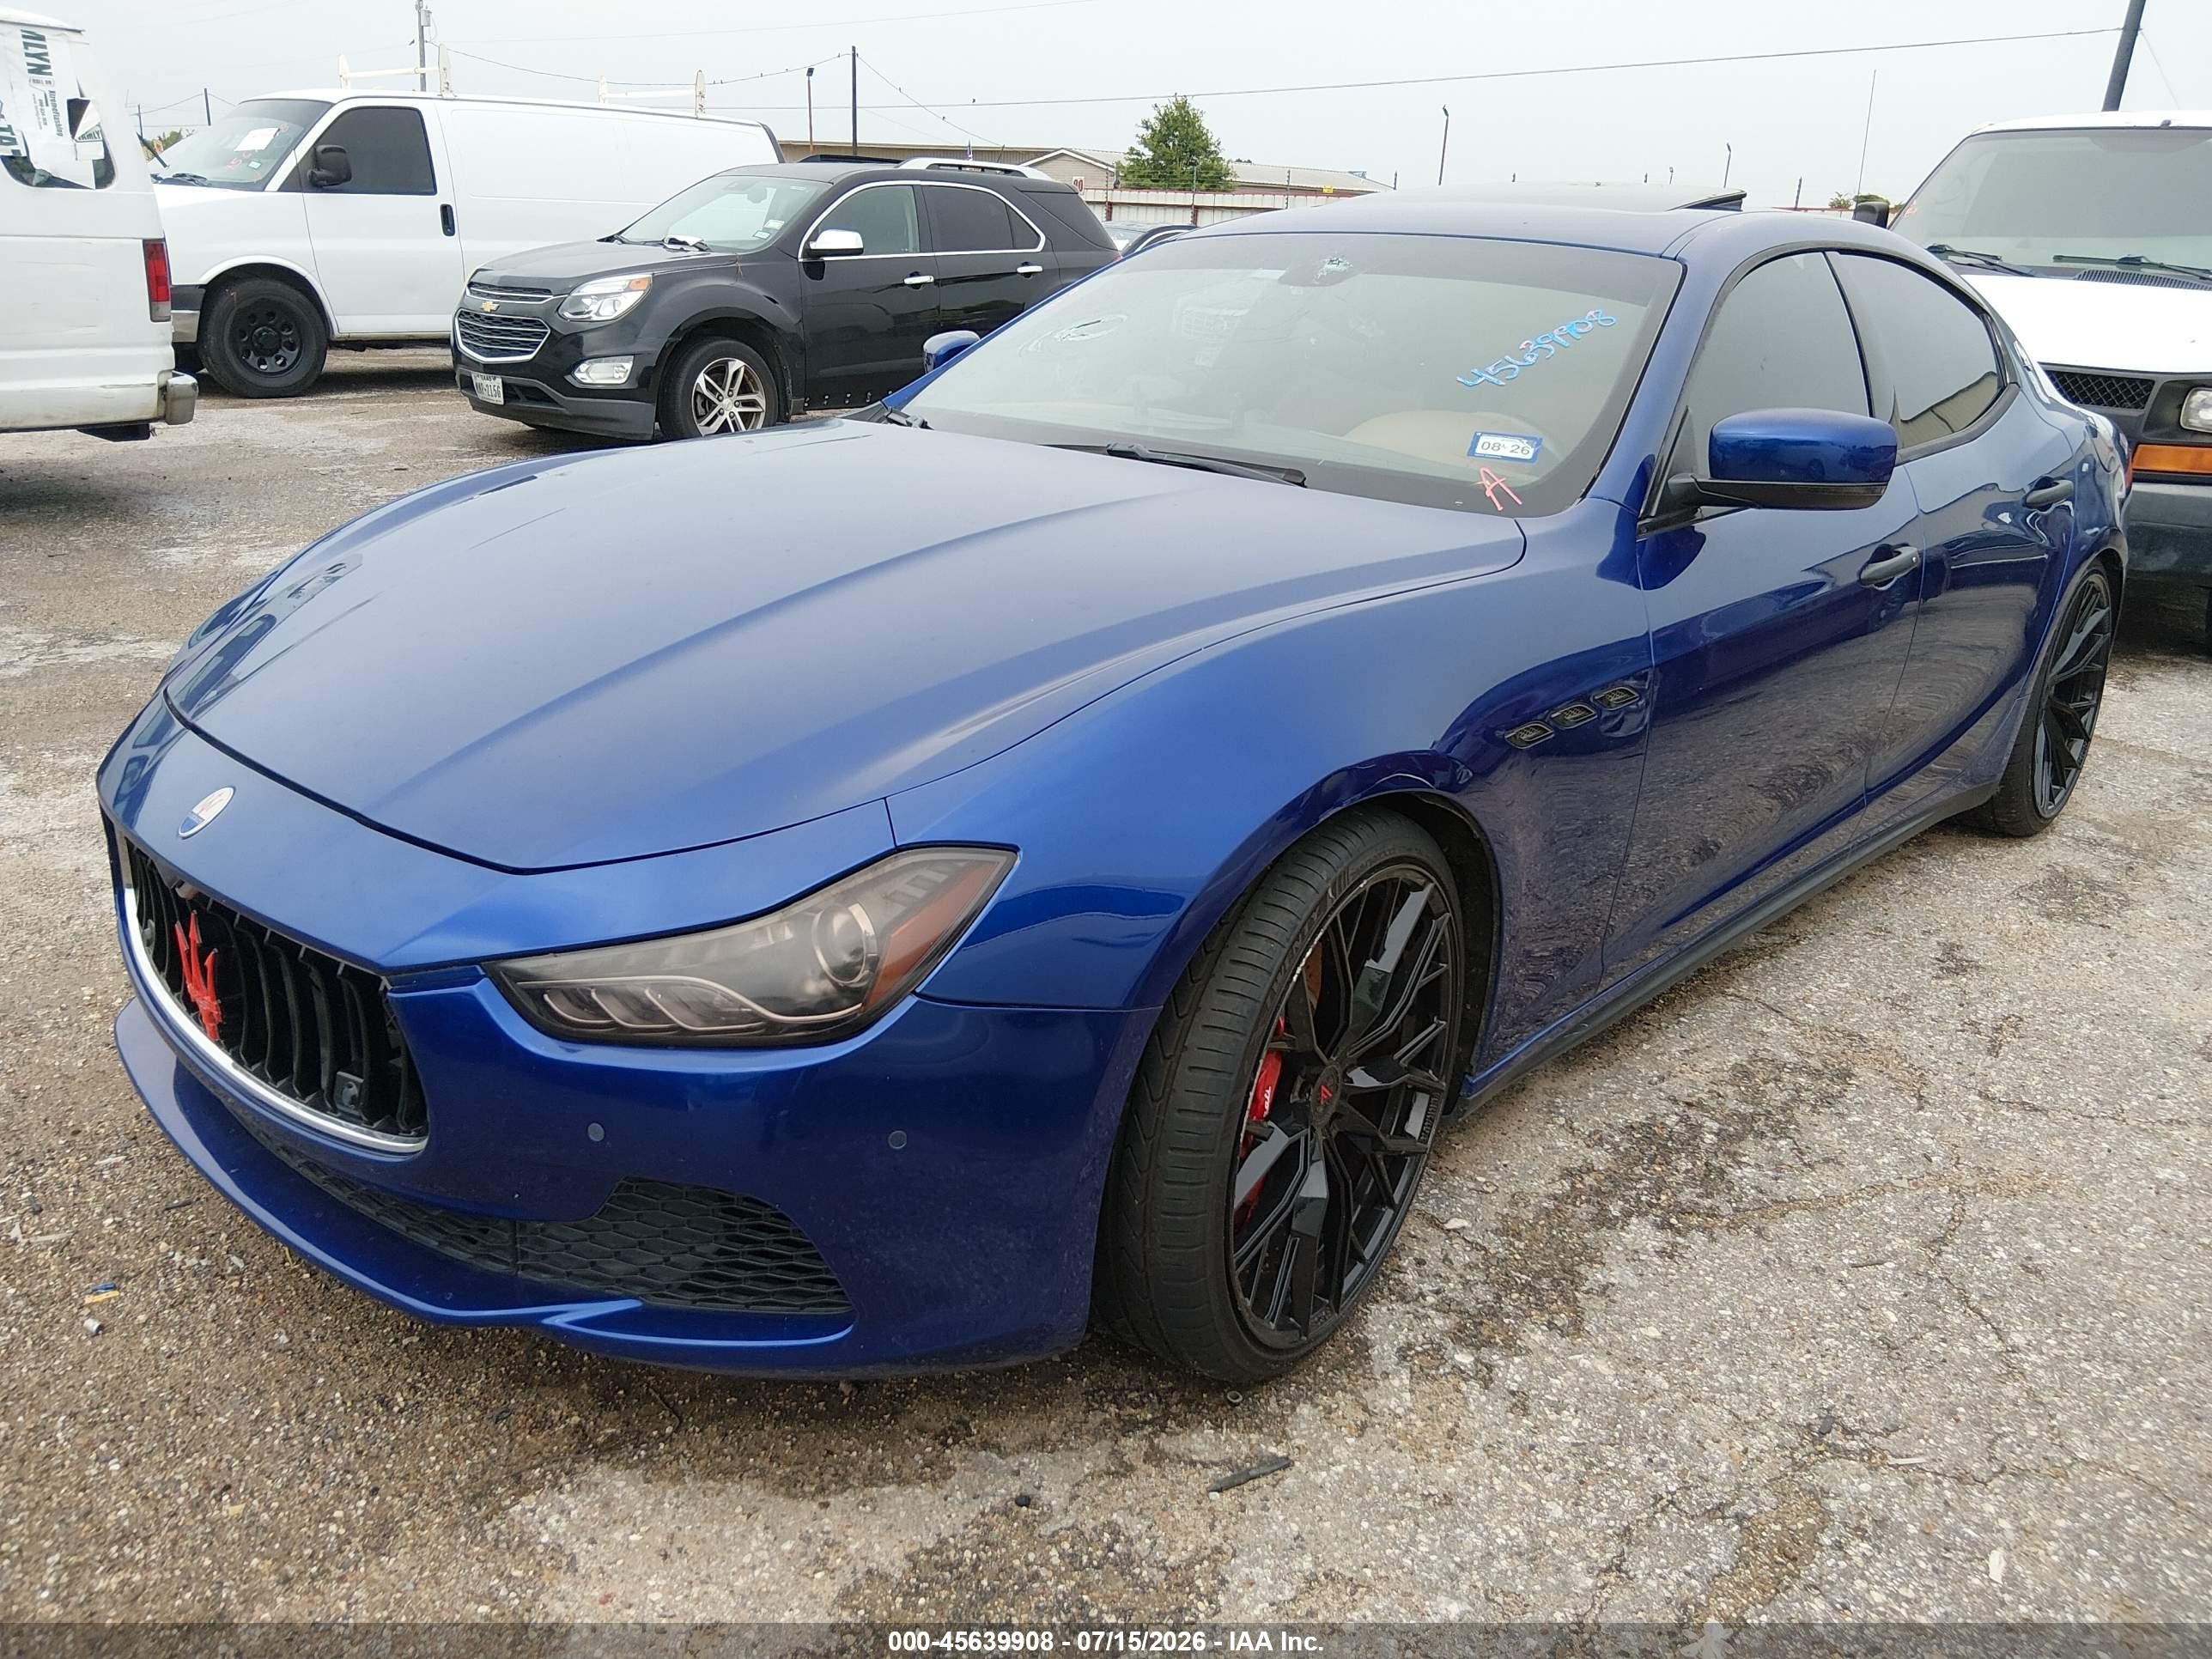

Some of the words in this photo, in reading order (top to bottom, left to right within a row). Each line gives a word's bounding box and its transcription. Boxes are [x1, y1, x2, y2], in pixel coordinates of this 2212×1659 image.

[1455, 308, 1617, 387] 45639908
[1480, 441, 1501, 452] 08
[1509, 444, 1531, 455] 26
